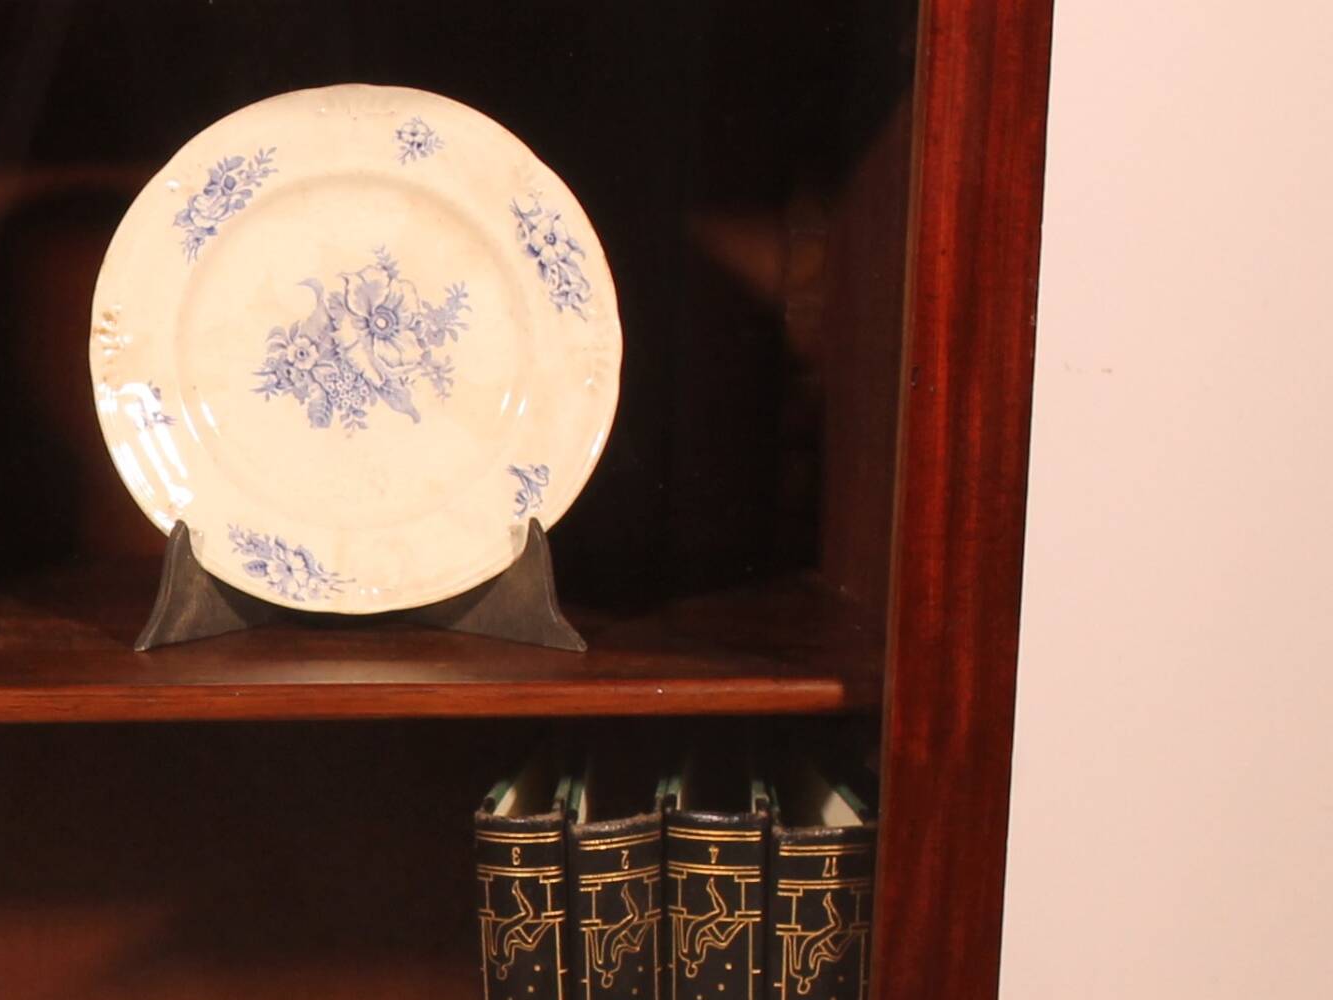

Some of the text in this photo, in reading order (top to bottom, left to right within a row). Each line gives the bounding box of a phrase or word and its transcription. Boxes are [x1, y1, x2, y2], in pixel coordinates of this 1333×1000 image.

[511, 846, 522, 867] 3
[620, 849, 630, 870] 2
[708, 845, 720, 865] 4
[821, 856, 840, 879] 17
